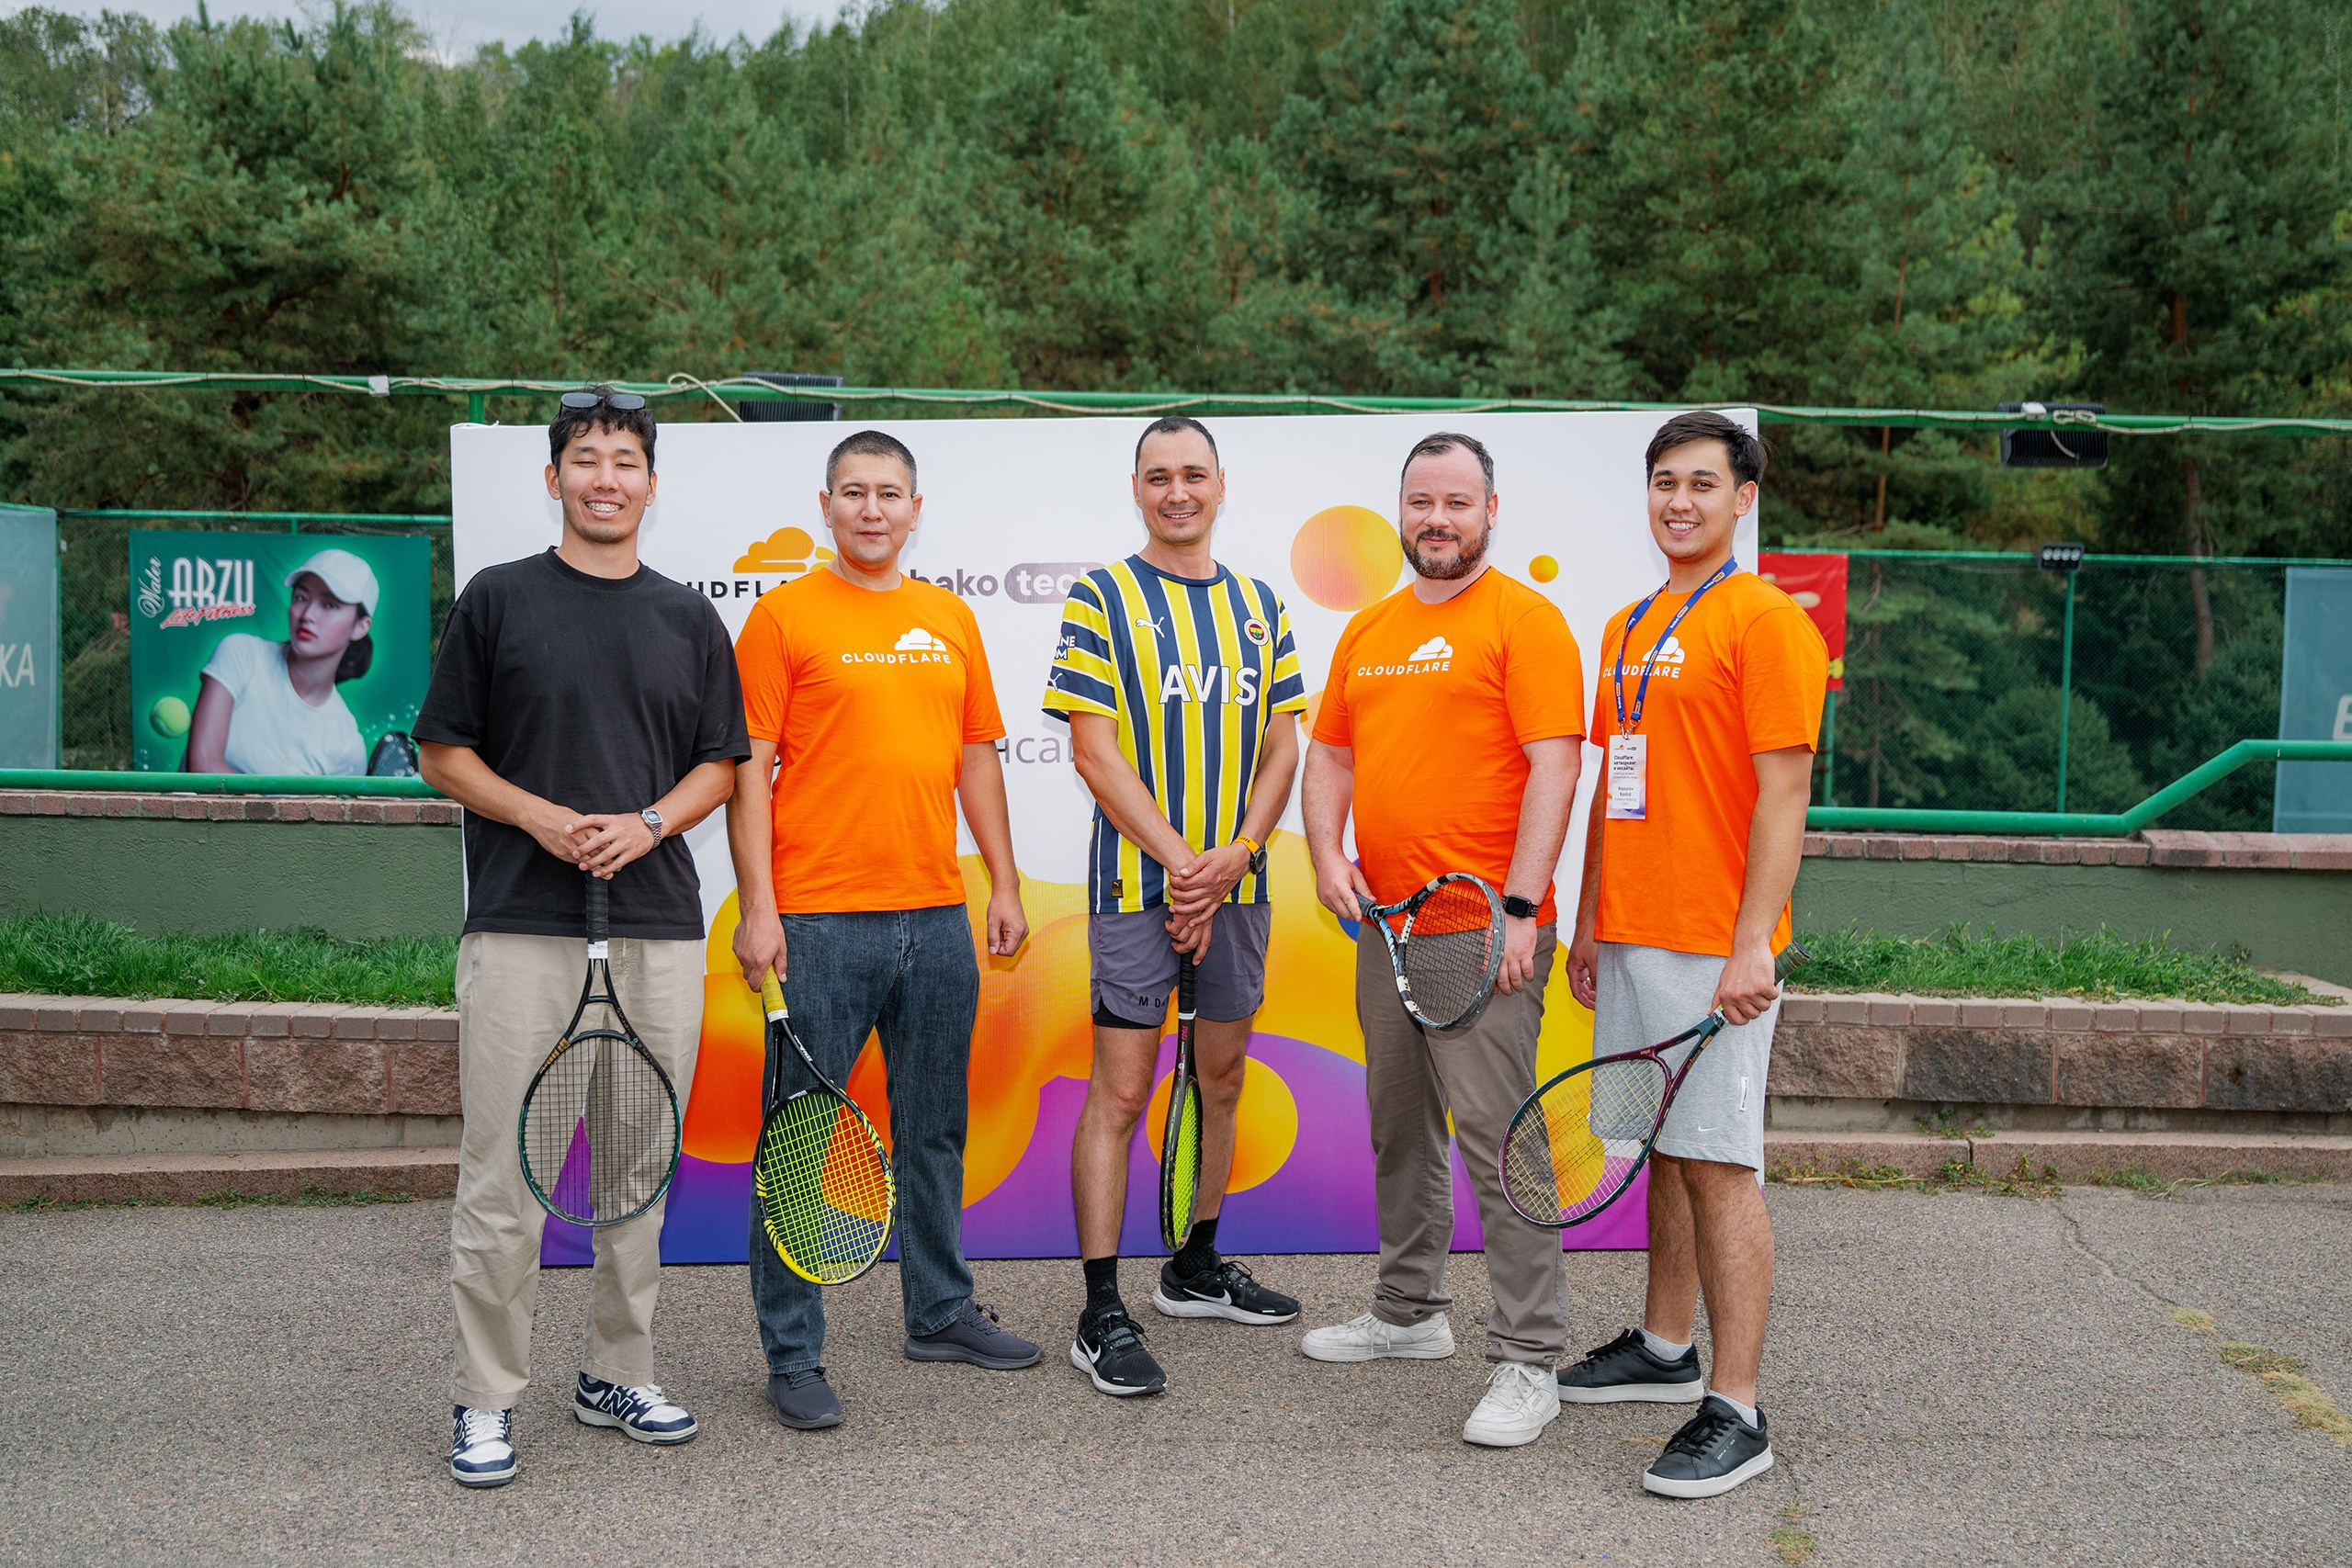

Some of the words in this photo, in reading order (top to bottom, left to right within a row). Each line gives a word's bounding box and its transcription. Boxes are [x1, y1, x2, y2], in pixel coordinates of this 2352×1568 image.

[167, 556, 254, 608] ARZU
[841, 652, 952, 664] CLOUDFLARE
[1357, 660, 1451, 677] CLOUDFLARE
[1158, 663, 1259, 706] AVIS
